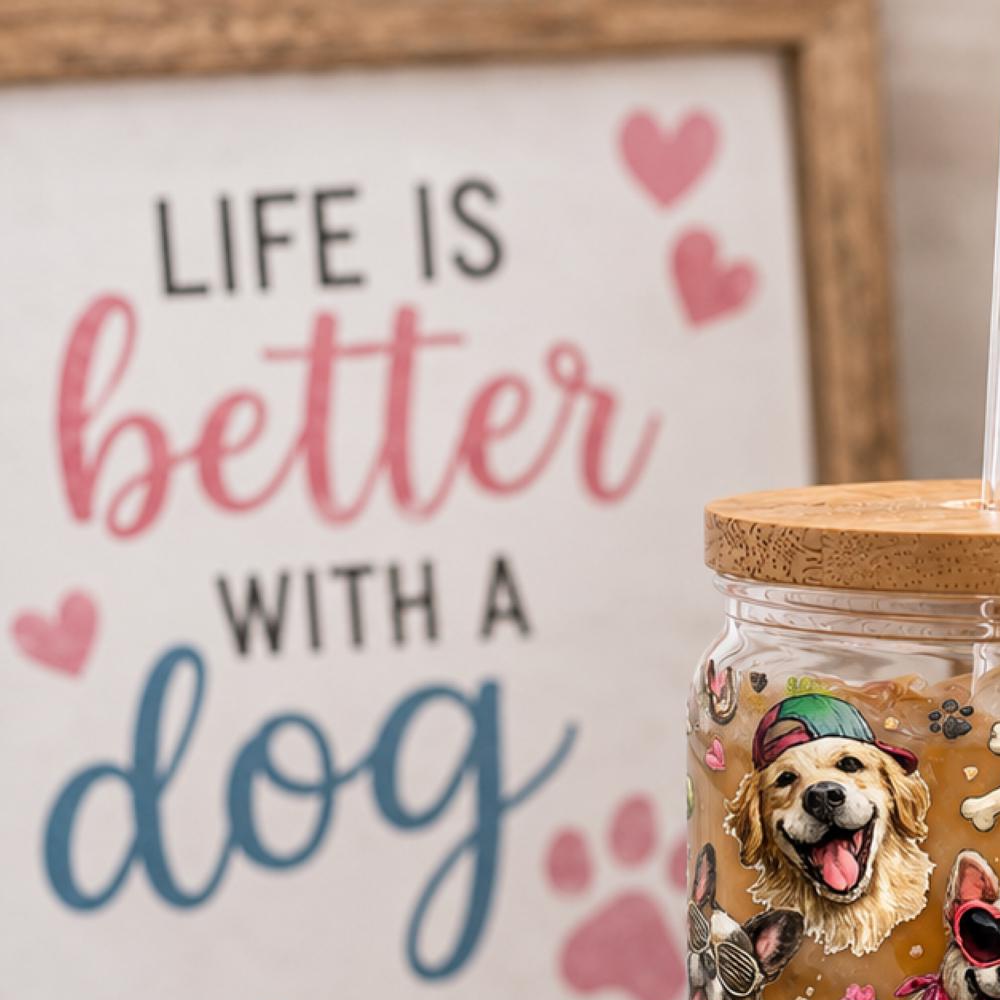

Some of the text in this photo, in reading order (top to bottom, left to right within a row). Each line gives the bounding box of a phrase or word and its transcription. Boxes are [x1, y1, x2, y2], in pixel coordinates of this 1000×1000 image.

[155, 177, 507, 300] LIFE IS
[54, 293, 662, 541] better
[215, 553, 533, 659] WITH A
[43, 643, 578, 984] dog
